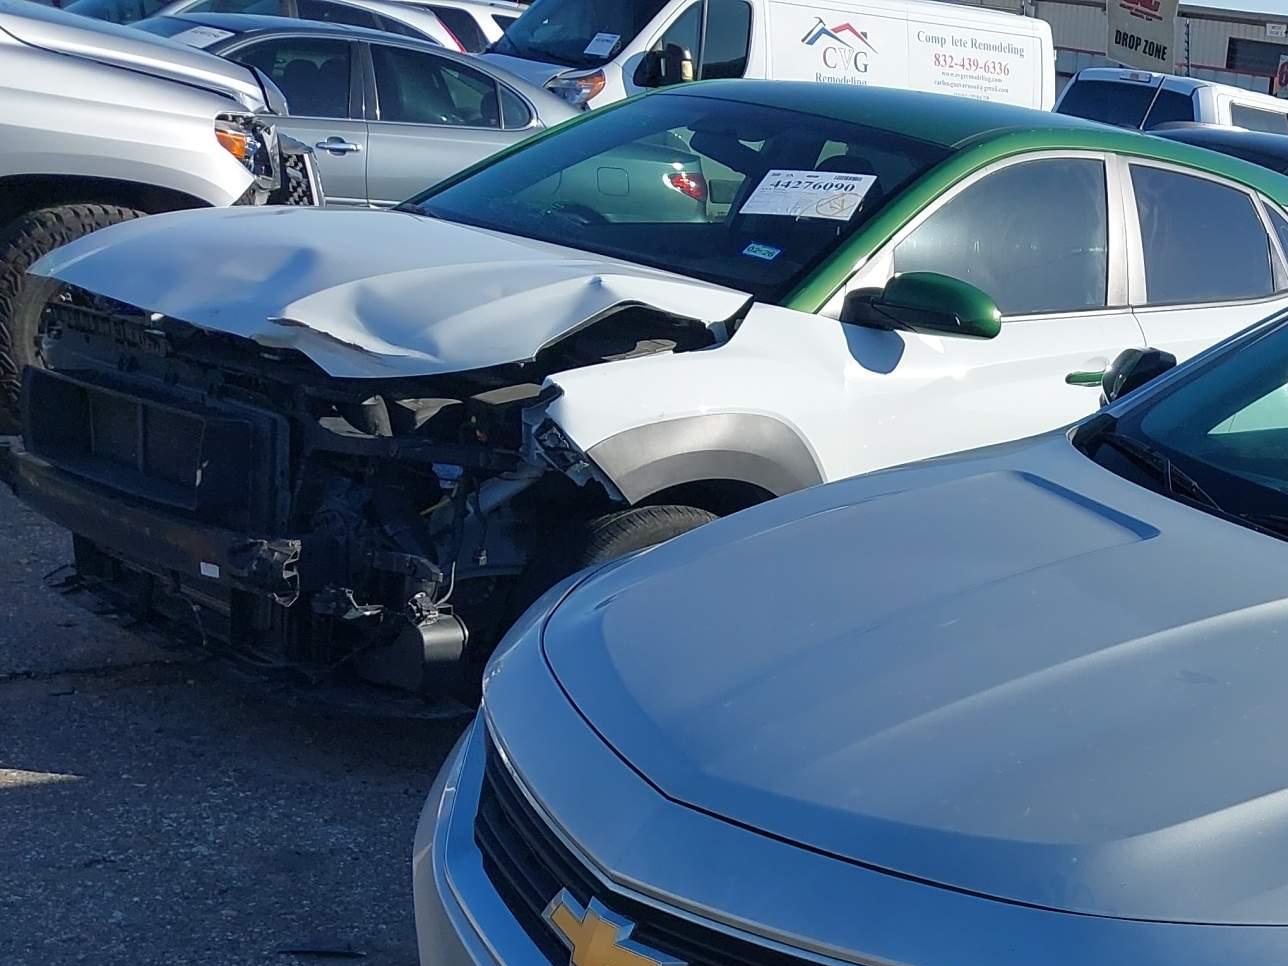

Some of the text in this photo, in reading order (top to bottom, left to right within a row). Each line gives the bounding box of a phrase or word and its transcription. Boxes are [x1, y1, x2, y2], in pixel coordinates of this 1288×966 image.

[917, 30, 946, 48] Comp
[970, 37, 1025, 58] Remodeling
[1114, 29, 1168, 61] DROP ZONE
[823, 46, 869, 73] CVG
[934, 52, 1010, 76] 832-439-6336
[769, 180, 856, 192] 44276090
